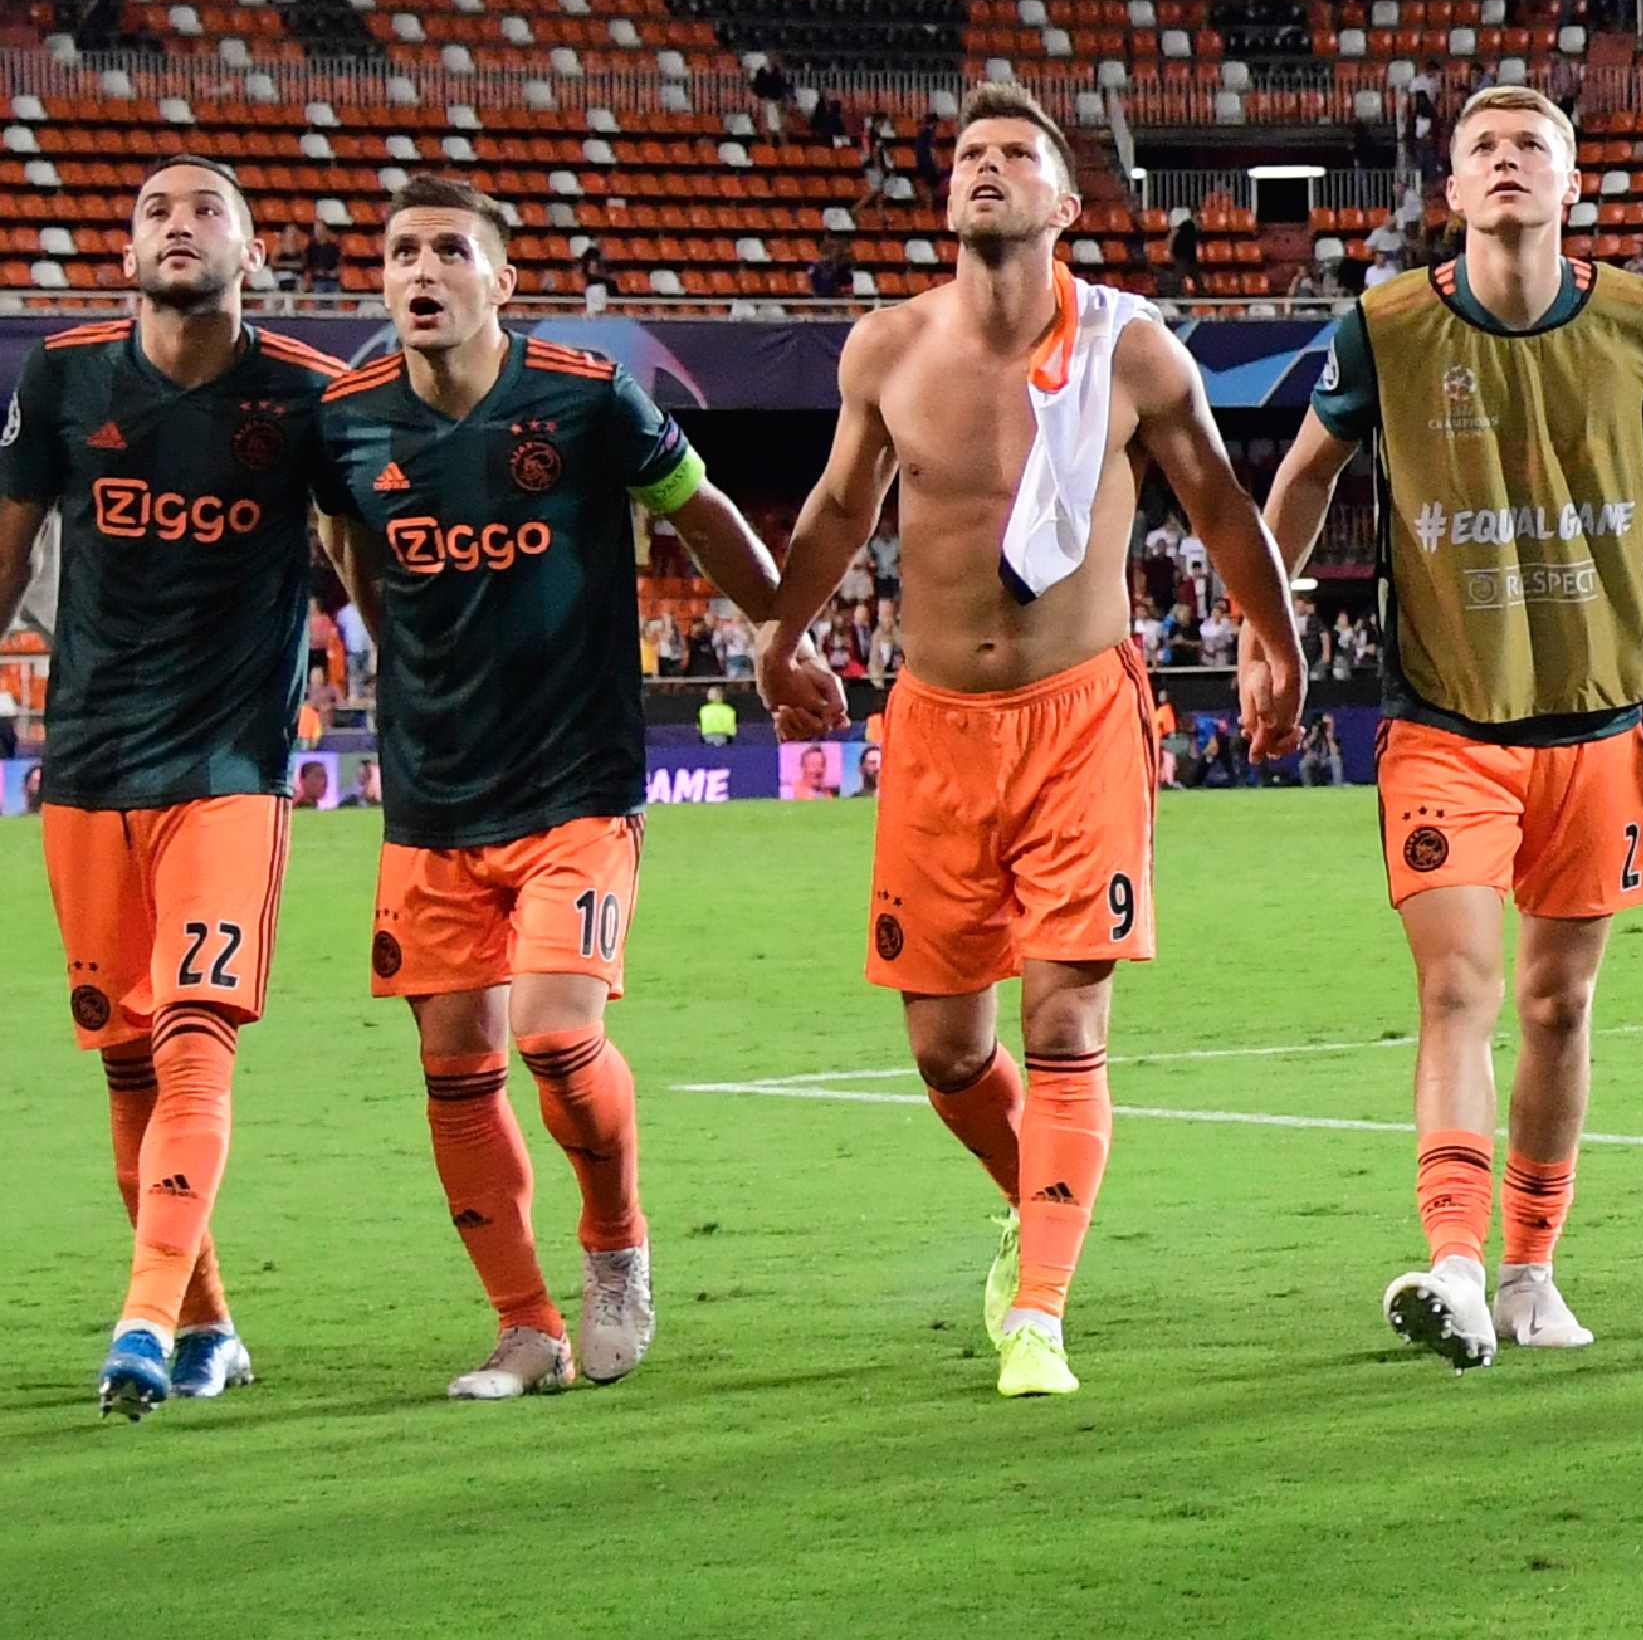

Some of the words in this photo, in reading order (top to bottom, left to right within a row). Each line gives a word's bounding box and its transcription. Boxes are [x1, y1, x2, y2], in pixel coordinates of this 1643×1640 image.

[93, 477, 260, 543] Ziggo
[1414, 501, 1554, 554] #EQUAL
[387, 516, 550, 574] Ziggo
[1505, 568, 1597, 596] RESPECT
[646, 768, 730, 803] AME
[1621, 823, 1641, 891] 2
[576, 888, 620, 962] 10
[1106, 870, 1135, 942] 9
[176, 920, 243, 990] 22
